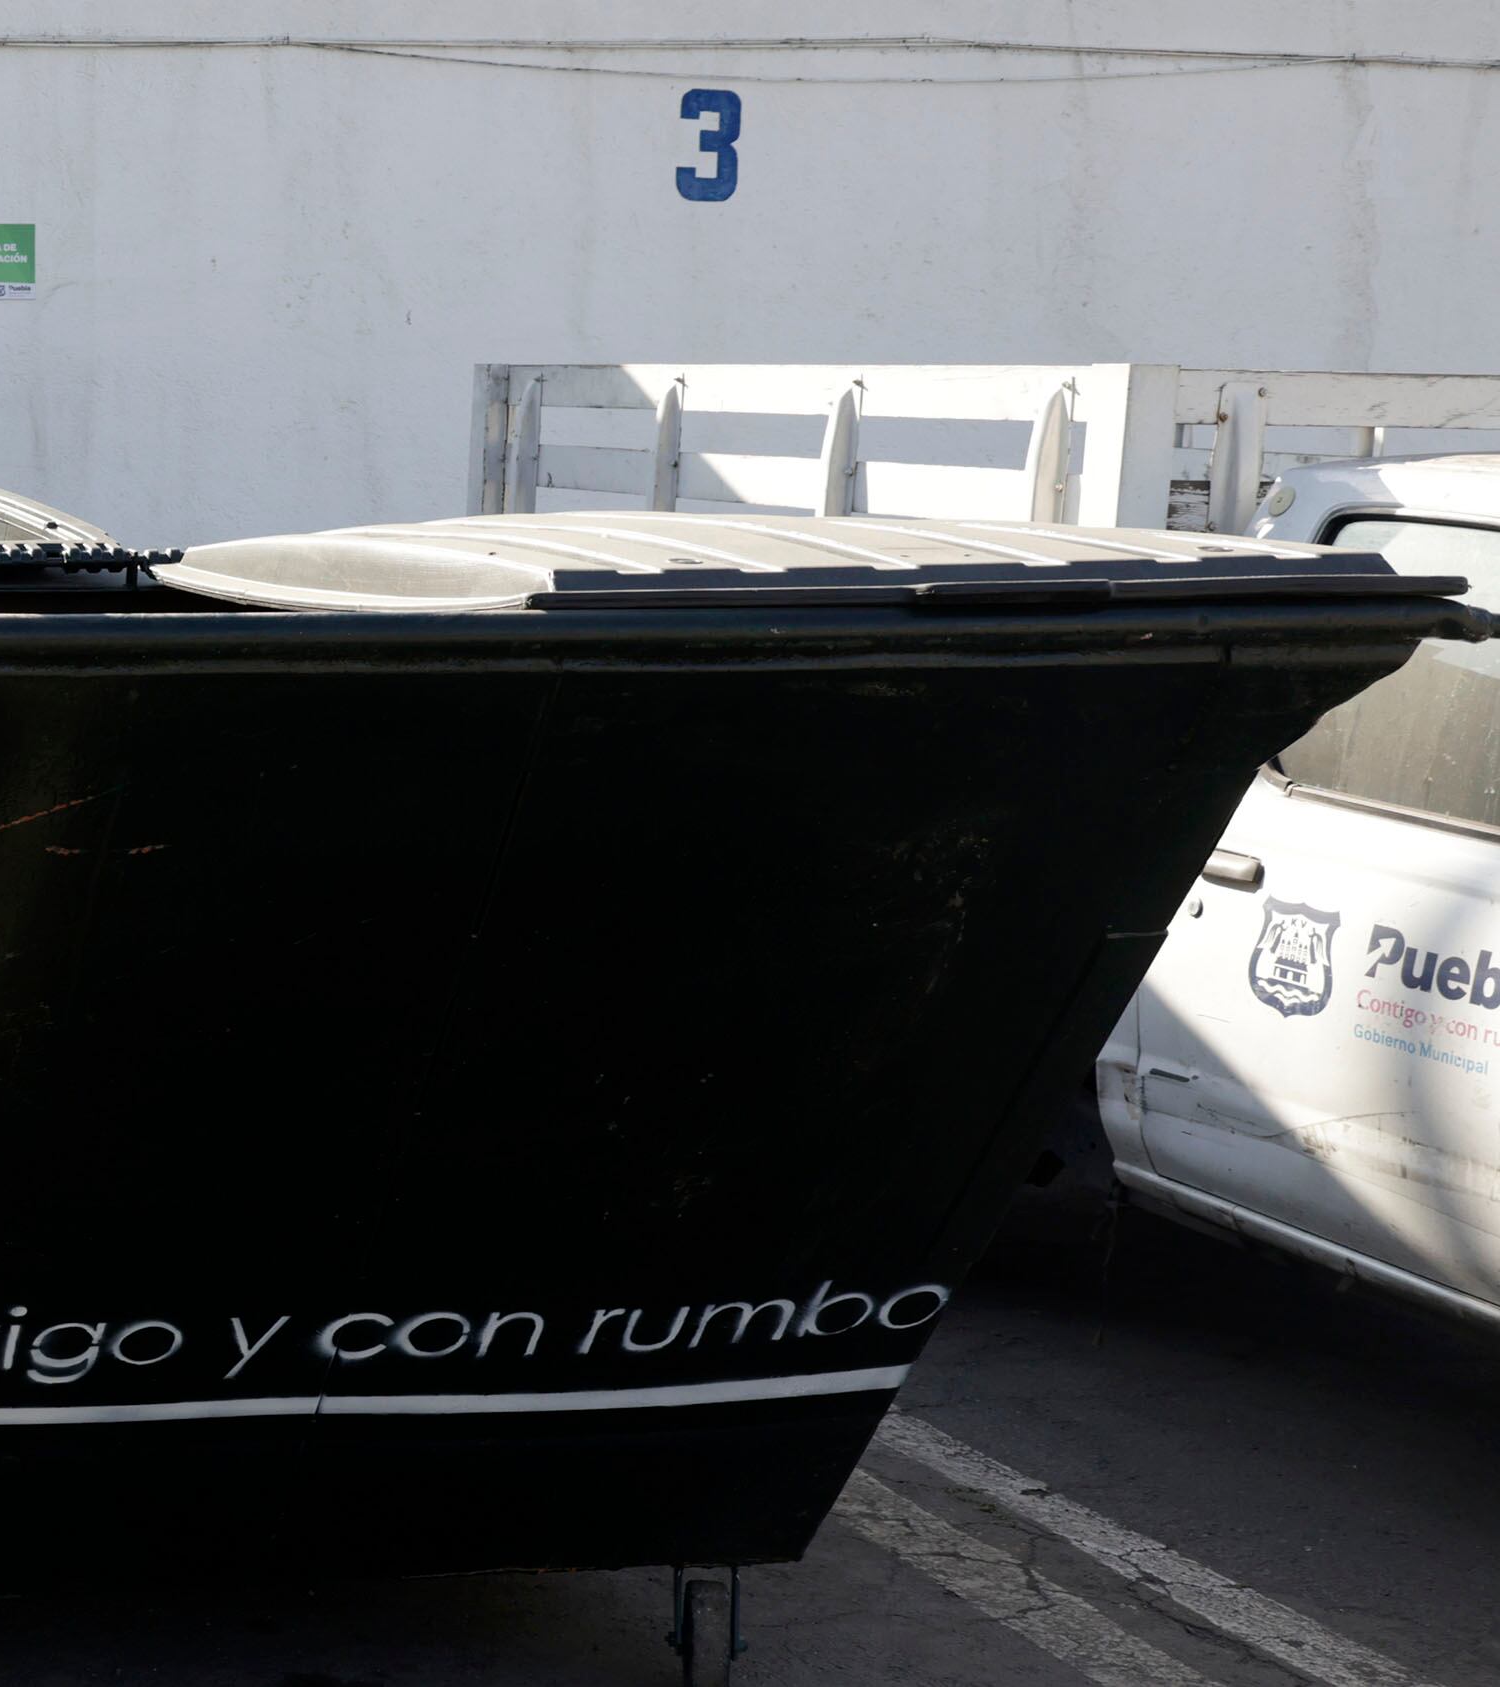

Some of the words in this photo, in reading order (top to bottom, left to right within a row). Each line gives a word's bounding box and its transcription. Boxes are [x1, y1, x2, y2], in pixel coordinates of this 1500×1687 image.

[676, 88, 741, 202] 3
[3, 243, 17, 252] DE
[1357, 989, 1426, 1029] Contigo
[1446, 1019, 1478, 1041] con
[1354, 1023, 1416, 1054] Gobierno
[1419, 1037, 1489, 1075] Municipal
[223, 1315, 291, 1380] y
[317, 1311, 545, 1361] con
[576, 1279, 951, 1354] rumbo
